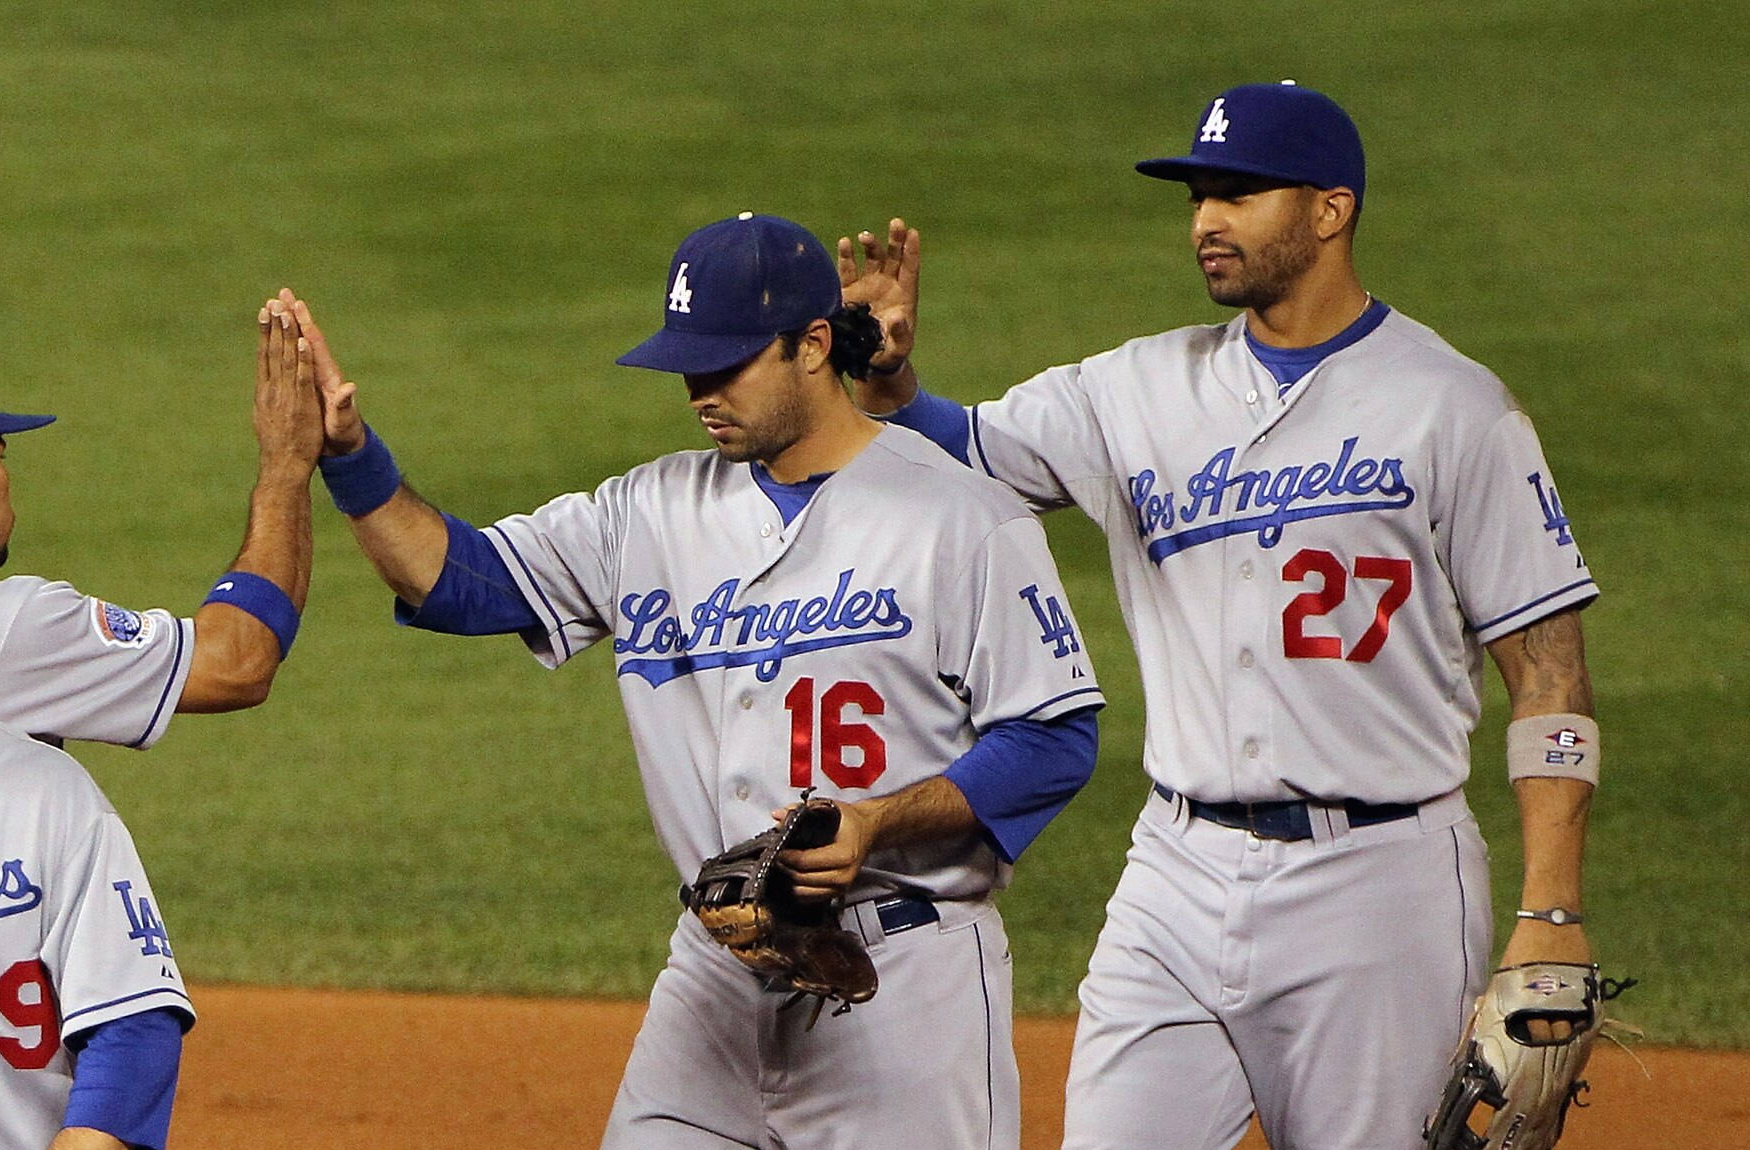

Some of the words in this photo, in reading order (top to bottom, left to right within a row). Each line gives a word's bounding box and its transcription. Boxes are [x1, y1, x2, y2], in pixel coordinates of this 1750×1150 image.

[1200, 98, 1229, 143] LA
[669, 262, 693, 314] LA
[1129, 469, 1176, 538] Los
[1180, 436, 1415, 549] Angeles
[1528, 472, 1572, 546] LA
[682, 568, 913, 683] Angeles
[1019, 584, 1080, 659] LA
[1282, 548, 1412, 664] 27
[784, 677, 887, 790] 16
[1546, 750, 1584, 766] 27
[113, 880, 171, 957] LA
